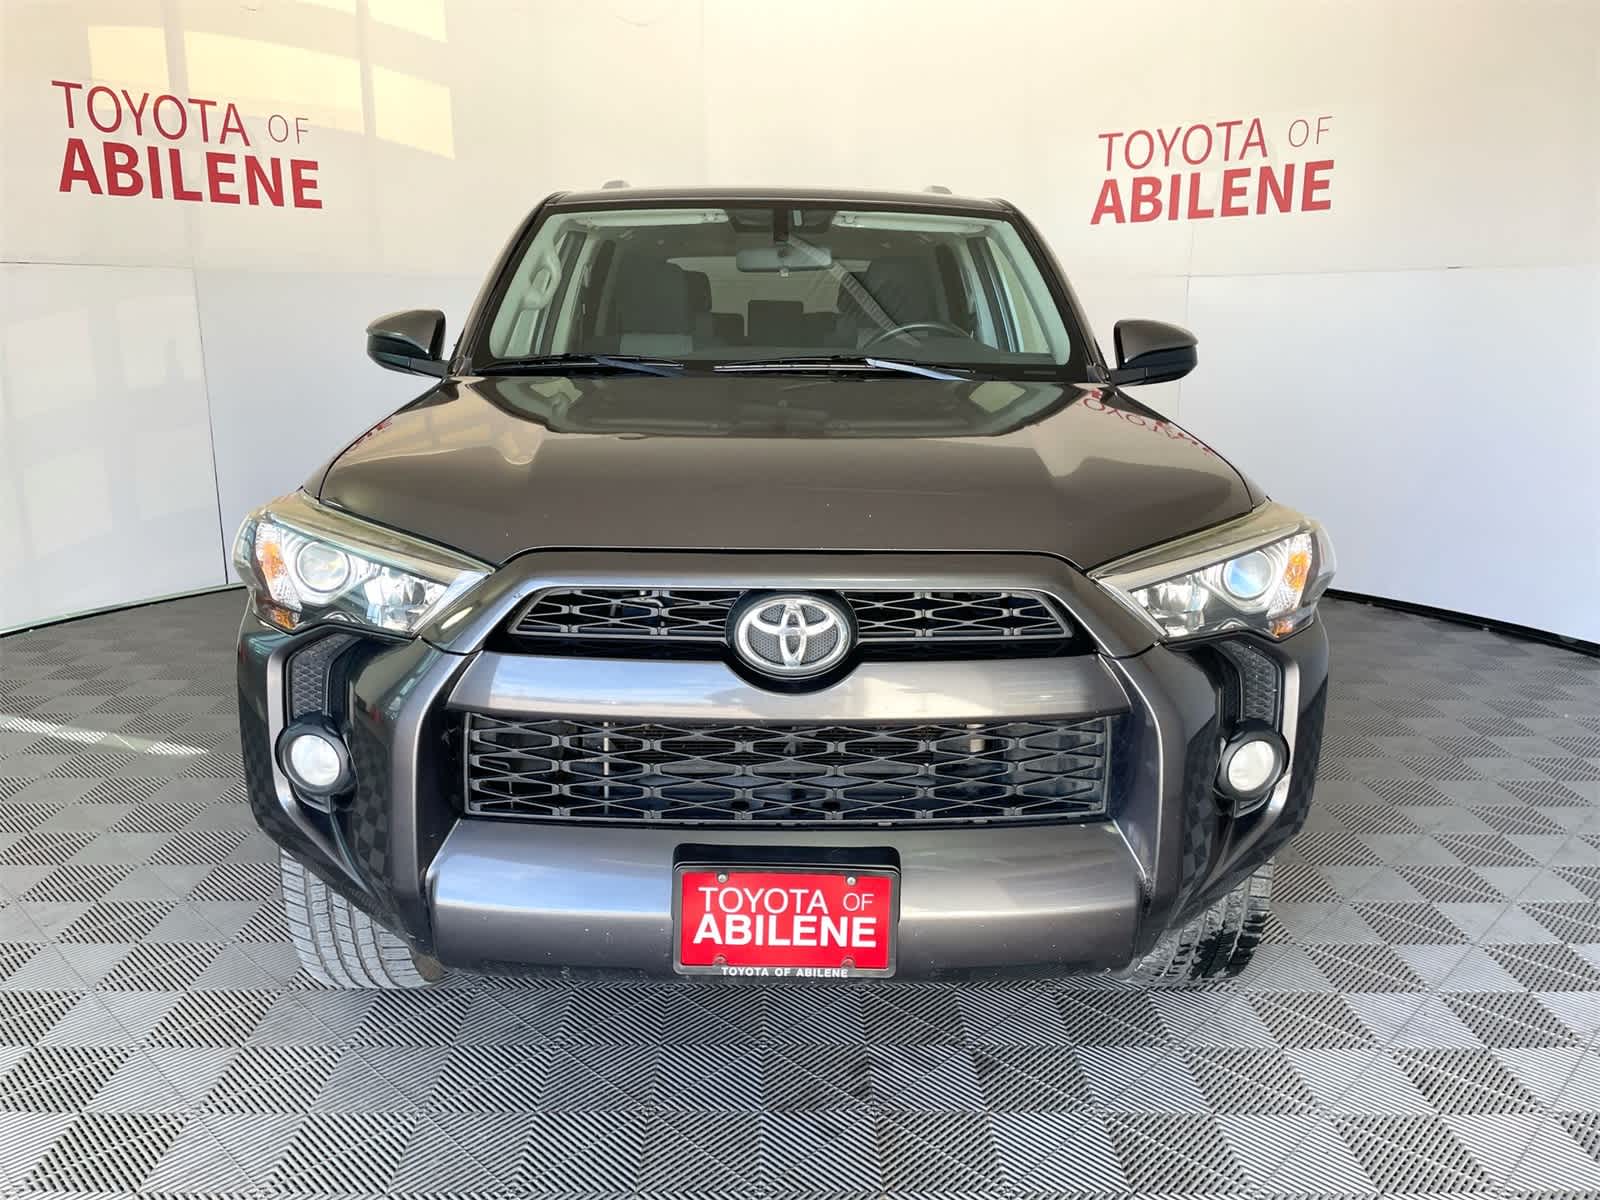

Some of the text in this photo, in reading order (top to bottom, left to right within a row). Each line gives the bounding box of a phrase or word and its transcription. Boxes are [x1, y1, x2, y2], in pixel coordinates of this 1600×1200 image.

[51, 80, 309, 146] TOYOTA OF
[1098, 116, 1333, 171] TOYOTA OF
[59, 138, 323, 209] ABILENE
[1090, 159, 1335, 225] ABILENE
[698, 887, 875, 914] TOYOTA OF
[692, 913, 877, 948] ABILENE
[721, 967, 848, 978] TOYOTA OF ABILENE
